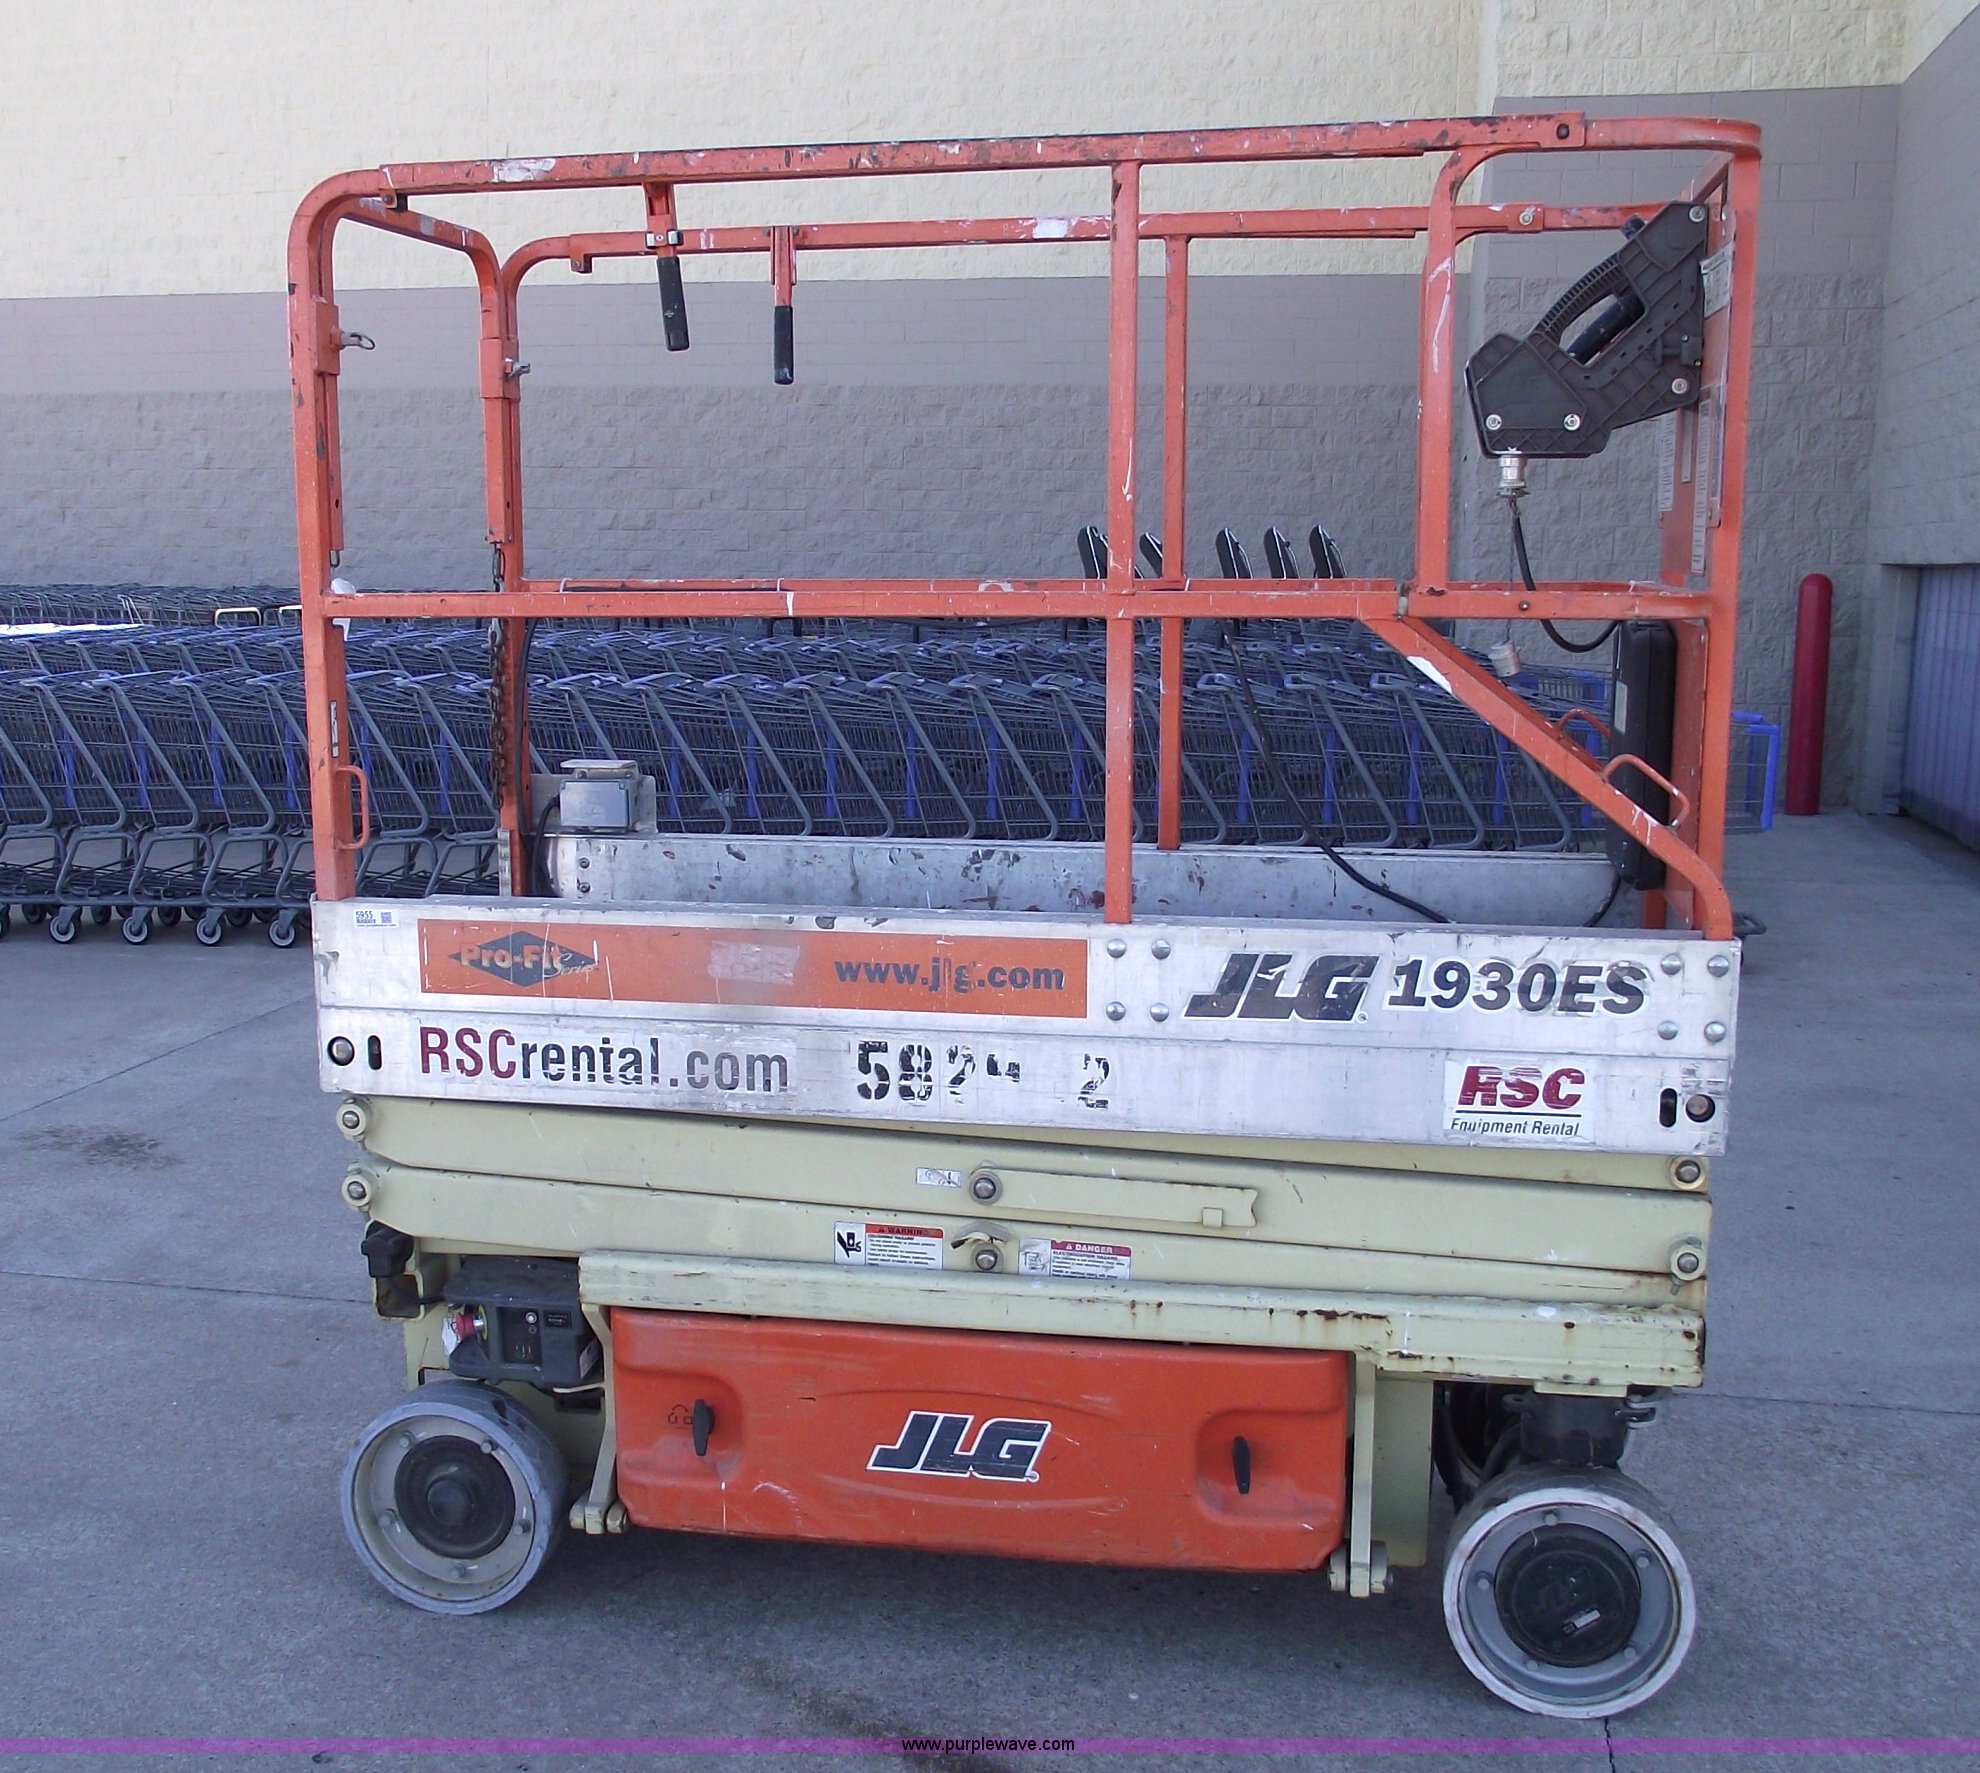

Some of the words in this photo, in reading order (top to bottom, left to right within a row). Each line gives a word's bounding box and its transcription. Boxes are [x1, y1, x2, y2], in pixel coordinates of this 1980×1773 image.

[355, 910, 373, 920] 5955
[460, 943, 561, 970] Pro-Fit
[1184, 953, 1380, 1022] JLG
[1387, 958, 1648, 1016] 1930ES
[420, 1026, 788, 1093] RSCrental.com
[1458, 1065, 1586, 1110] RSC
[1531, 1120, 1580, 1137] Rental
[1075, 1243, 1113, 1254] DANGER
[866, 1410, 1052, 1482] JLG
